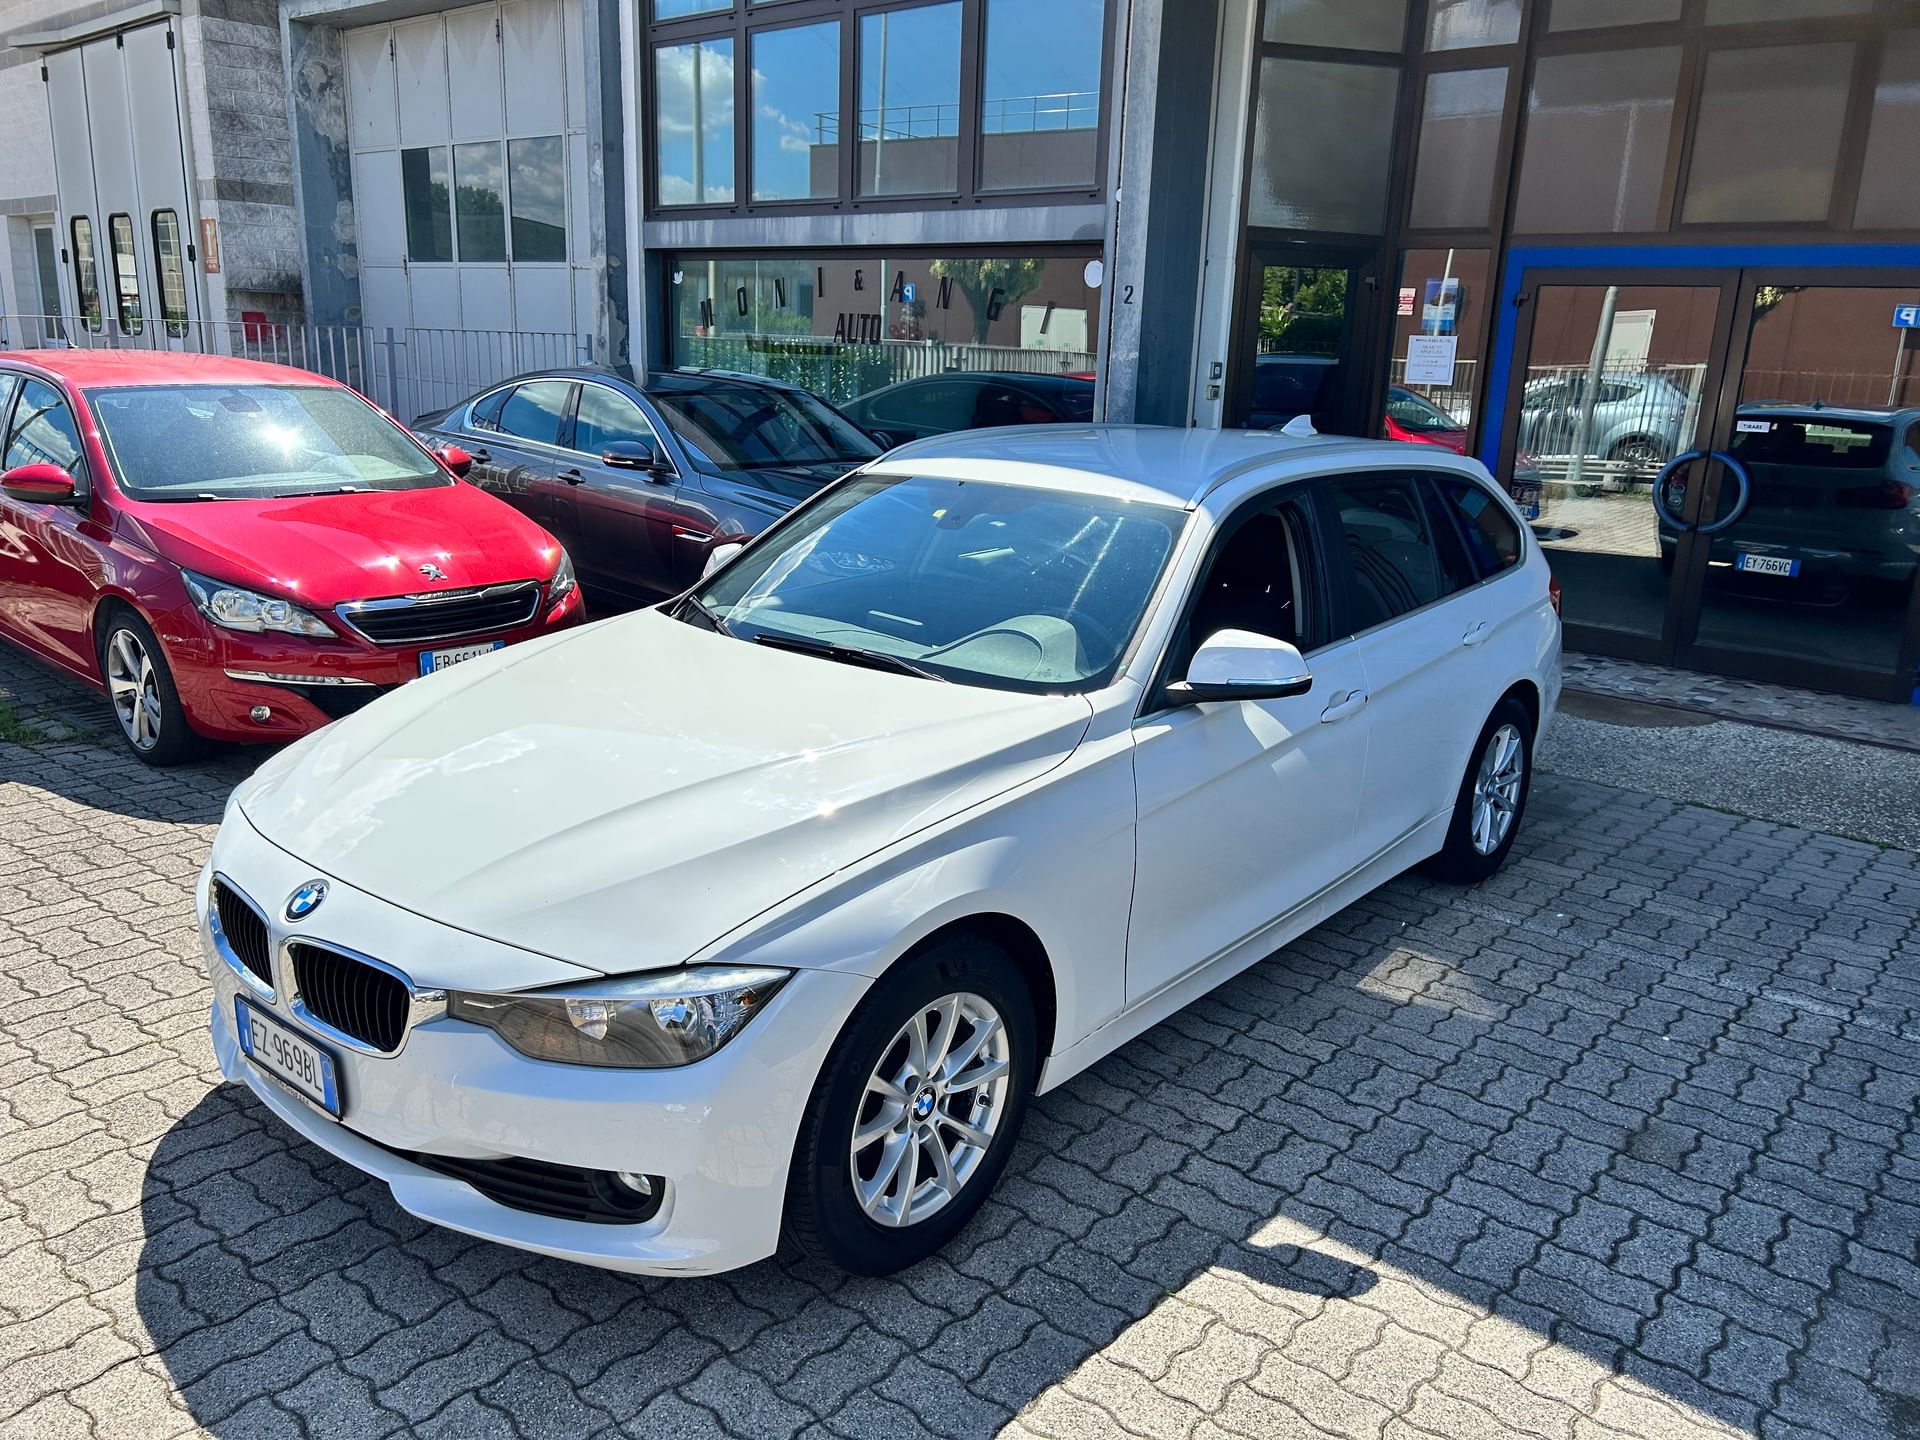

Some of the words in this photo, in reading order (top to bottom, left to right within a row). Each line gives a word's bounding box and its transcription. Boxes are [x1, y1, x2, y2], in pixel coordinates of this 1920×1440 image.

[700, 266, 823, 329] MONI
[854, 269, 863, 291] &
[1124, 285, 1134, 305] 2
[833, 312, 882, 345] AUTO
[1760, 558, 1790, 573] 766VC
[251, 1018, 271, 1058] EZ
[273, 1033, 323, 1093] 969BL
